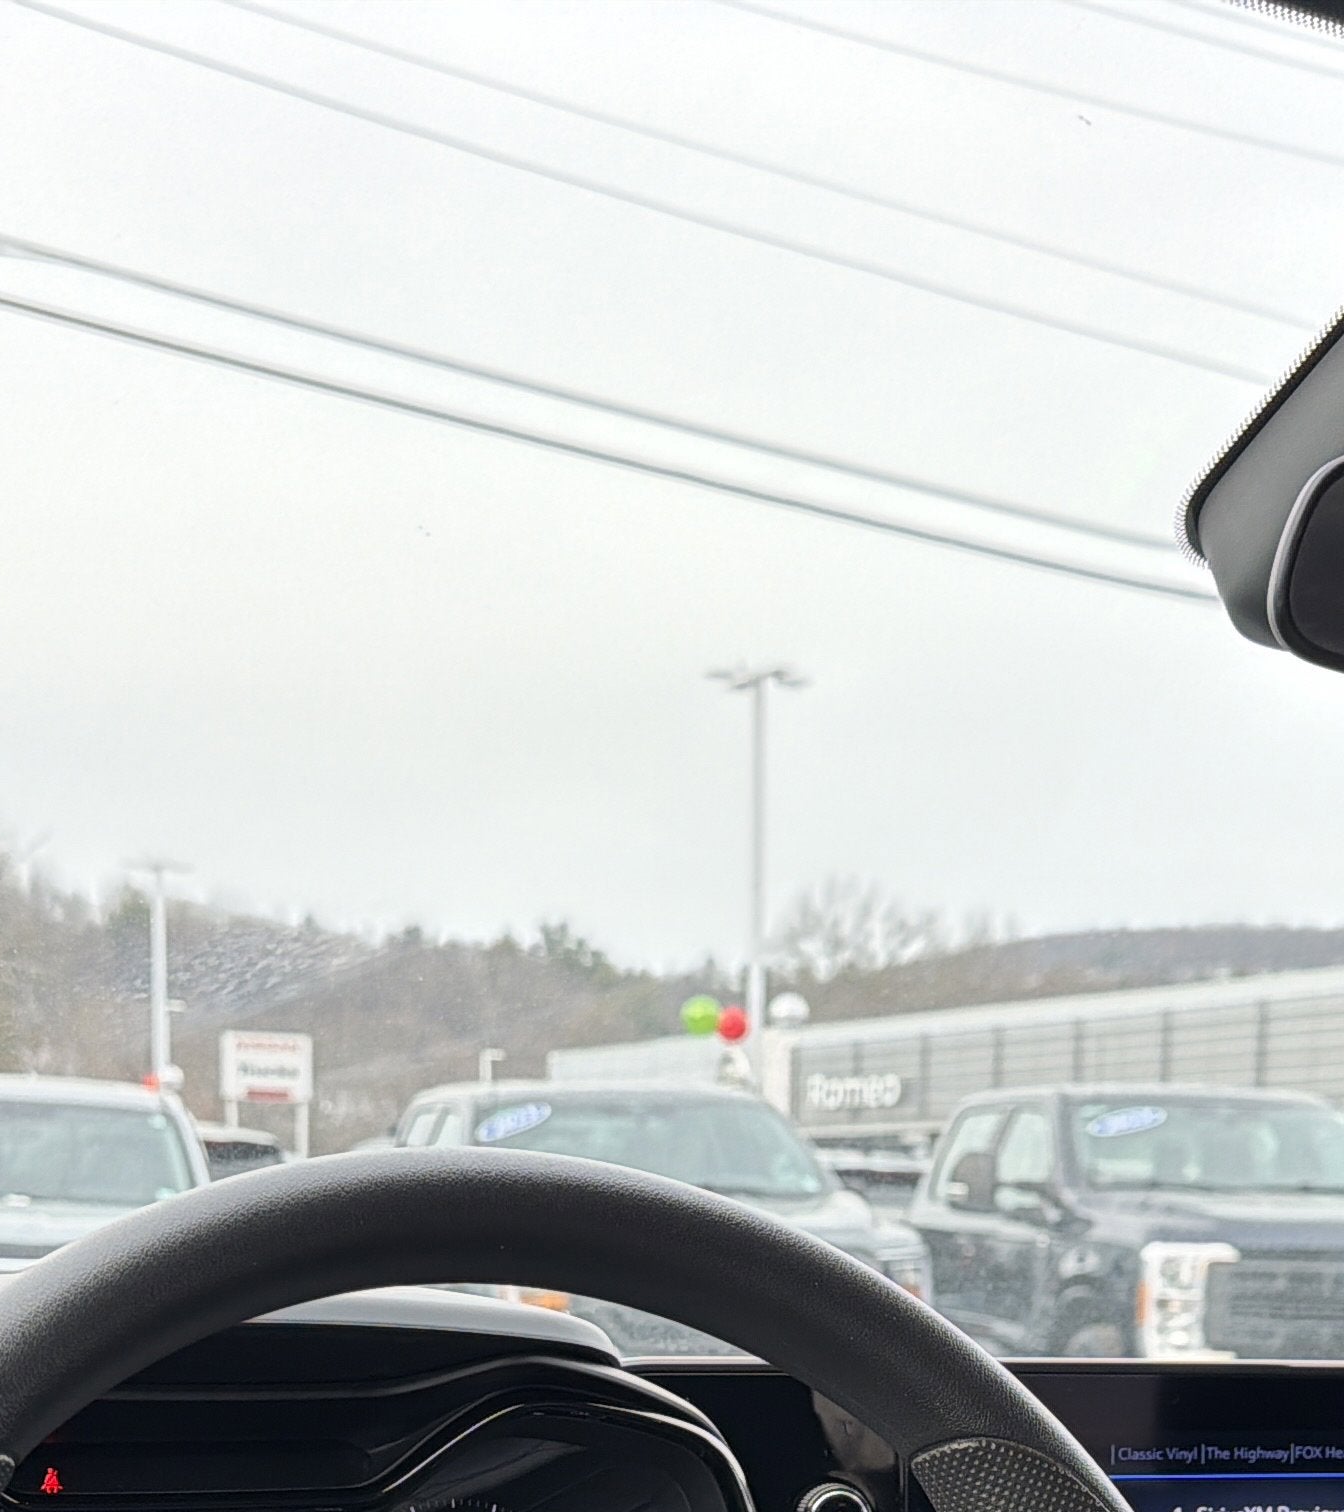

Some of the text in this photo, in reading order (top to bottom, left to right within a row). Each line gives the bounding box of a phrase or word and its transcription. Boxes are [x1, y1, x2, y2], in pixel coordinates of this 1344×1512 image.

[1118, 1446, 1198, 1461] Classic Vinyl
[1207, 1445, 1290, 1464] The Highway
[1295, 1446, 1323, 1460] FOX
